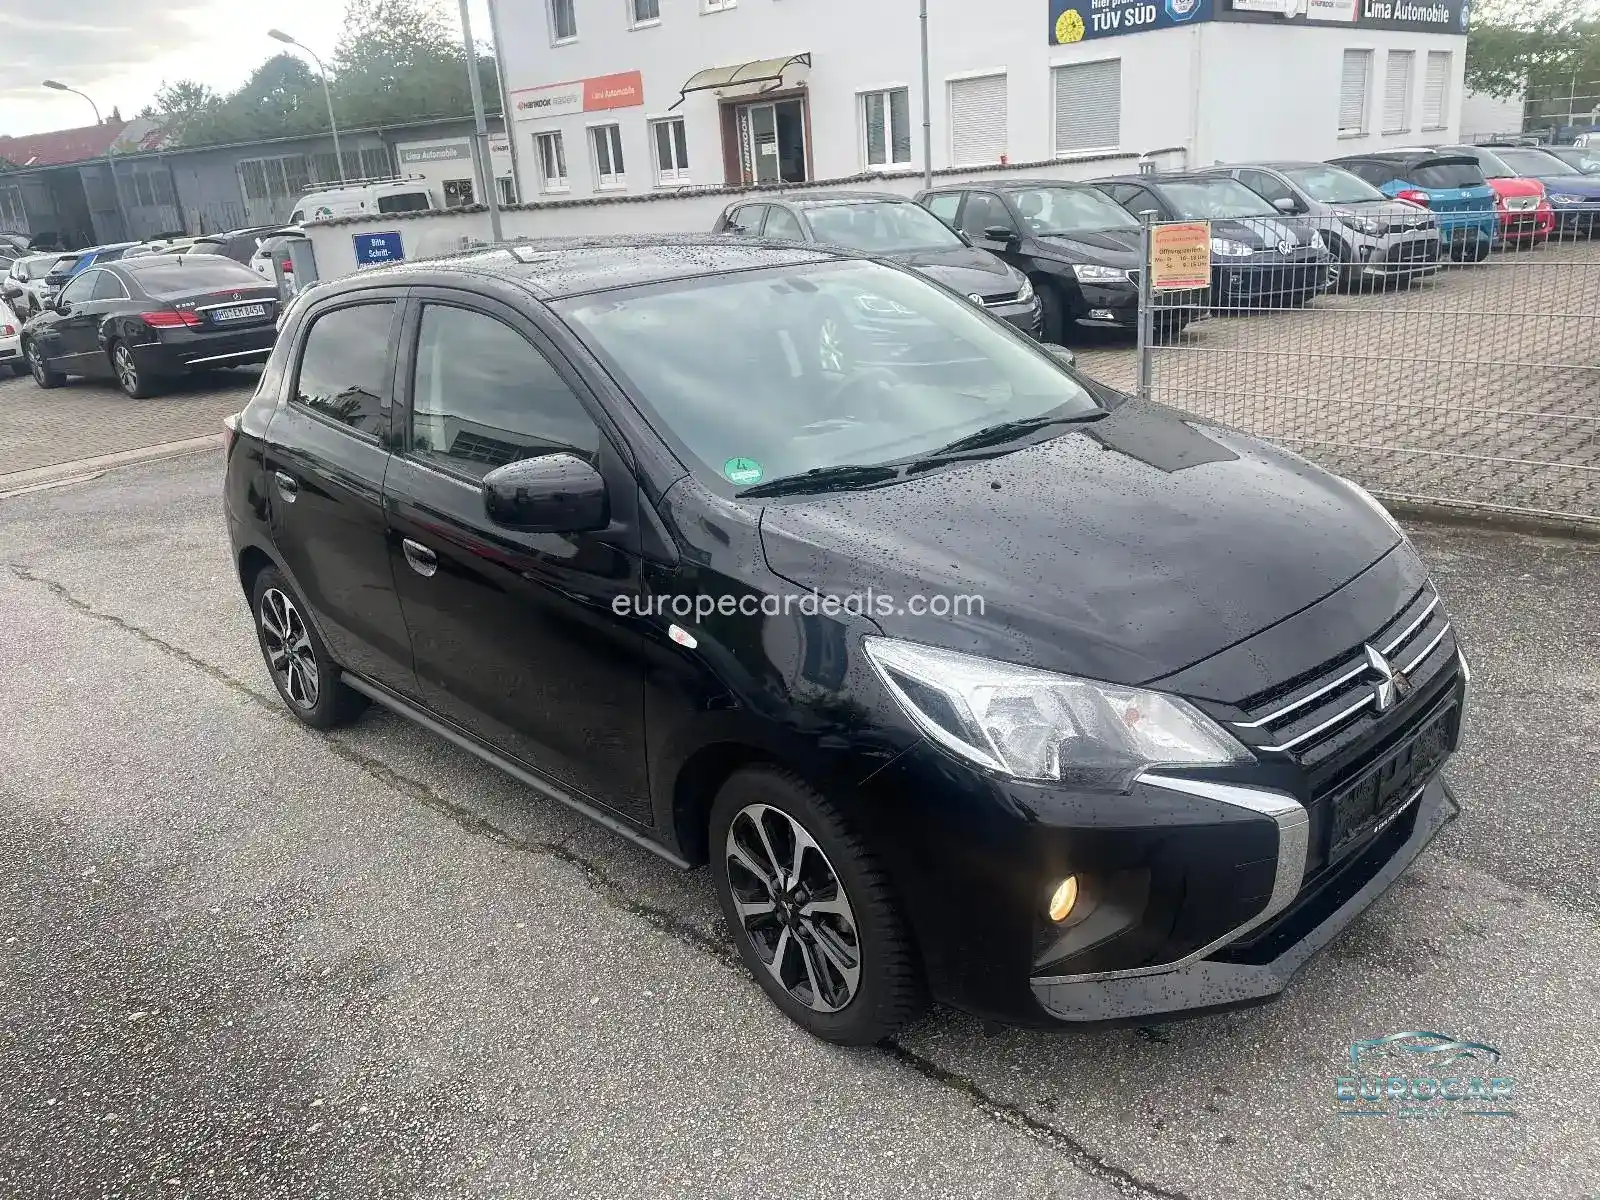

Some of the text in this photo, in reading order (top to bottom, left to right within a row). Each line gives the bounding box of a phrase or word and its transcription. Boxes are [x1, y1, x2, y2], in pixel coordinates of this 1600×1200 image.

[1091, 9, 1121, 31] TÜV
[1124, 3, 1156, 26] SÜD
[1364, 0, 1449, 23] Lima Automobile
[406, 148, 457, 160] Lima Automobile
[369, 249, 392, 257] Schritt-
[245, 306, 263, 315] 8454
